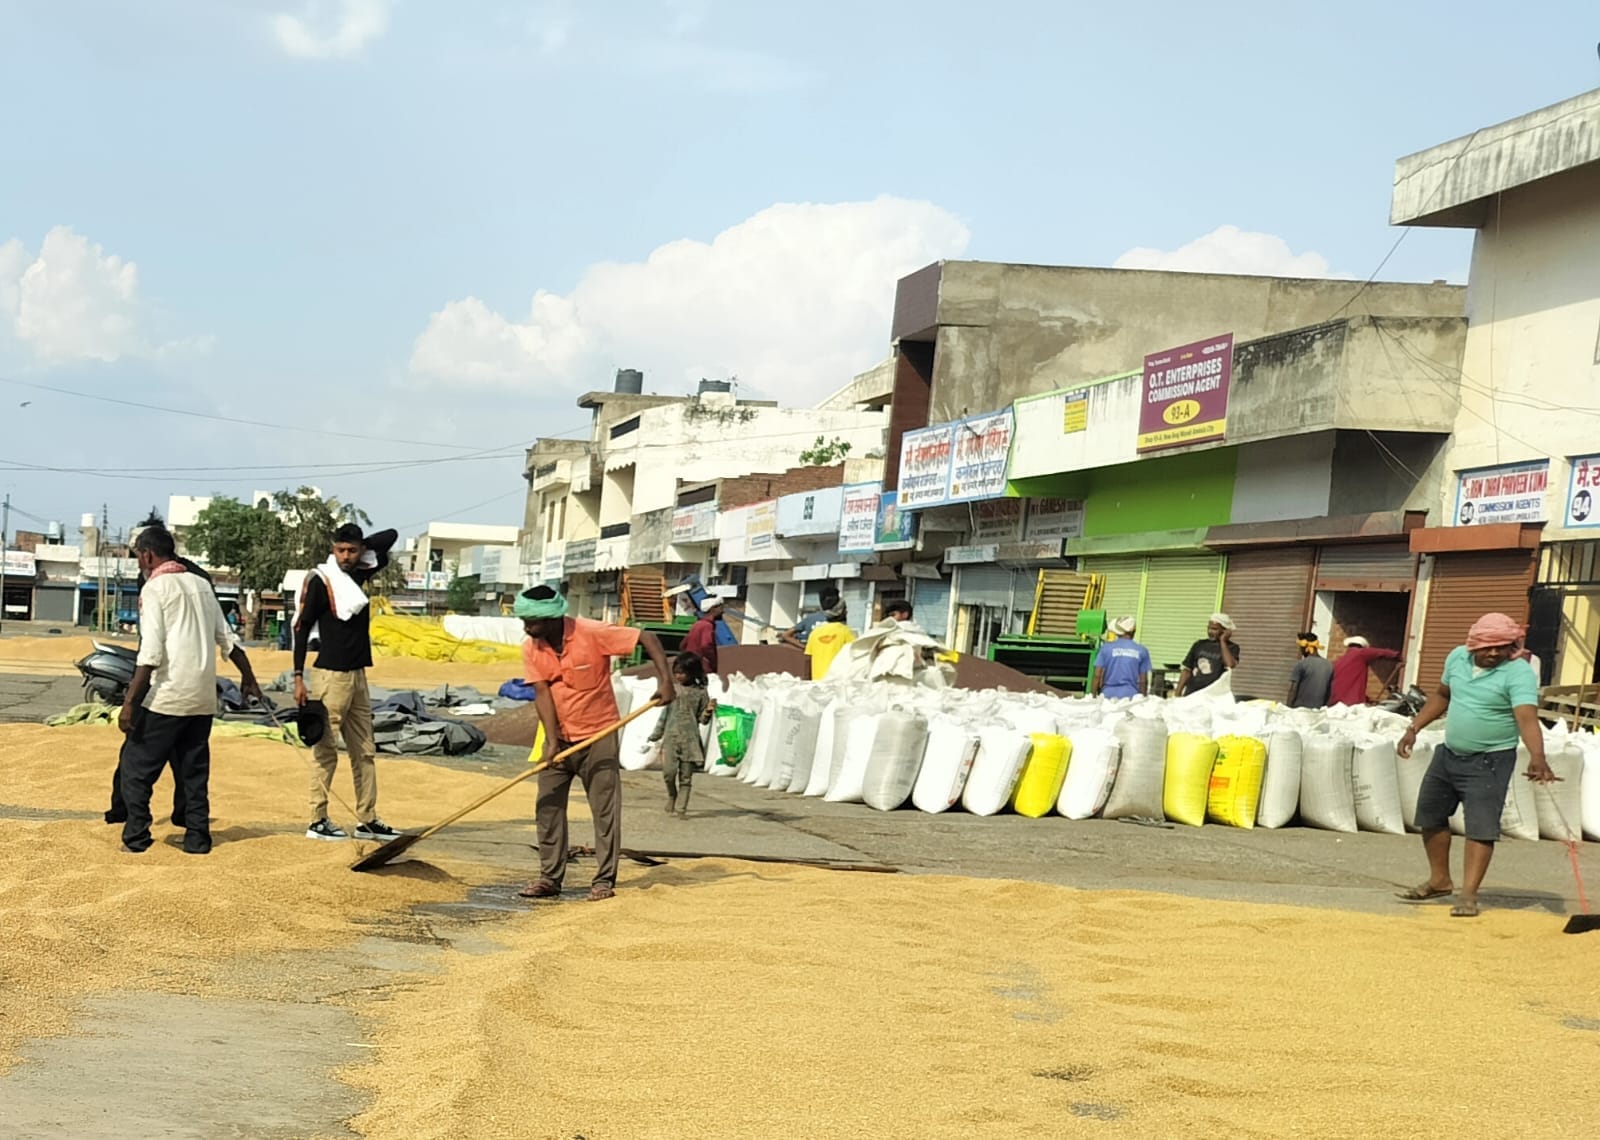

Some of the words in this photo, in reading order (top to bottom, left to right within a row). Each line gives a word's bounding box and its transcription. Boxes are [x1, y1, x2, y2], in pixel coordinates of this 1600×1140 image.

[1149, 372, 1164, 388] O.T.
[1166, 357, 1222, 385] ENTERPRISES
[1148, 380, 1195, 403] COMMISSION
[1195, 375, 1221, 394] AGENT
[1171, 403, 1190, 420] 93-A
[1461, 505, 1474, 521] 94
[1478, 500, 1513, 514] COMMISSION
[1515, 498, 1541, 509] AGENTS
[1572, 496, 1591, 516] 94
